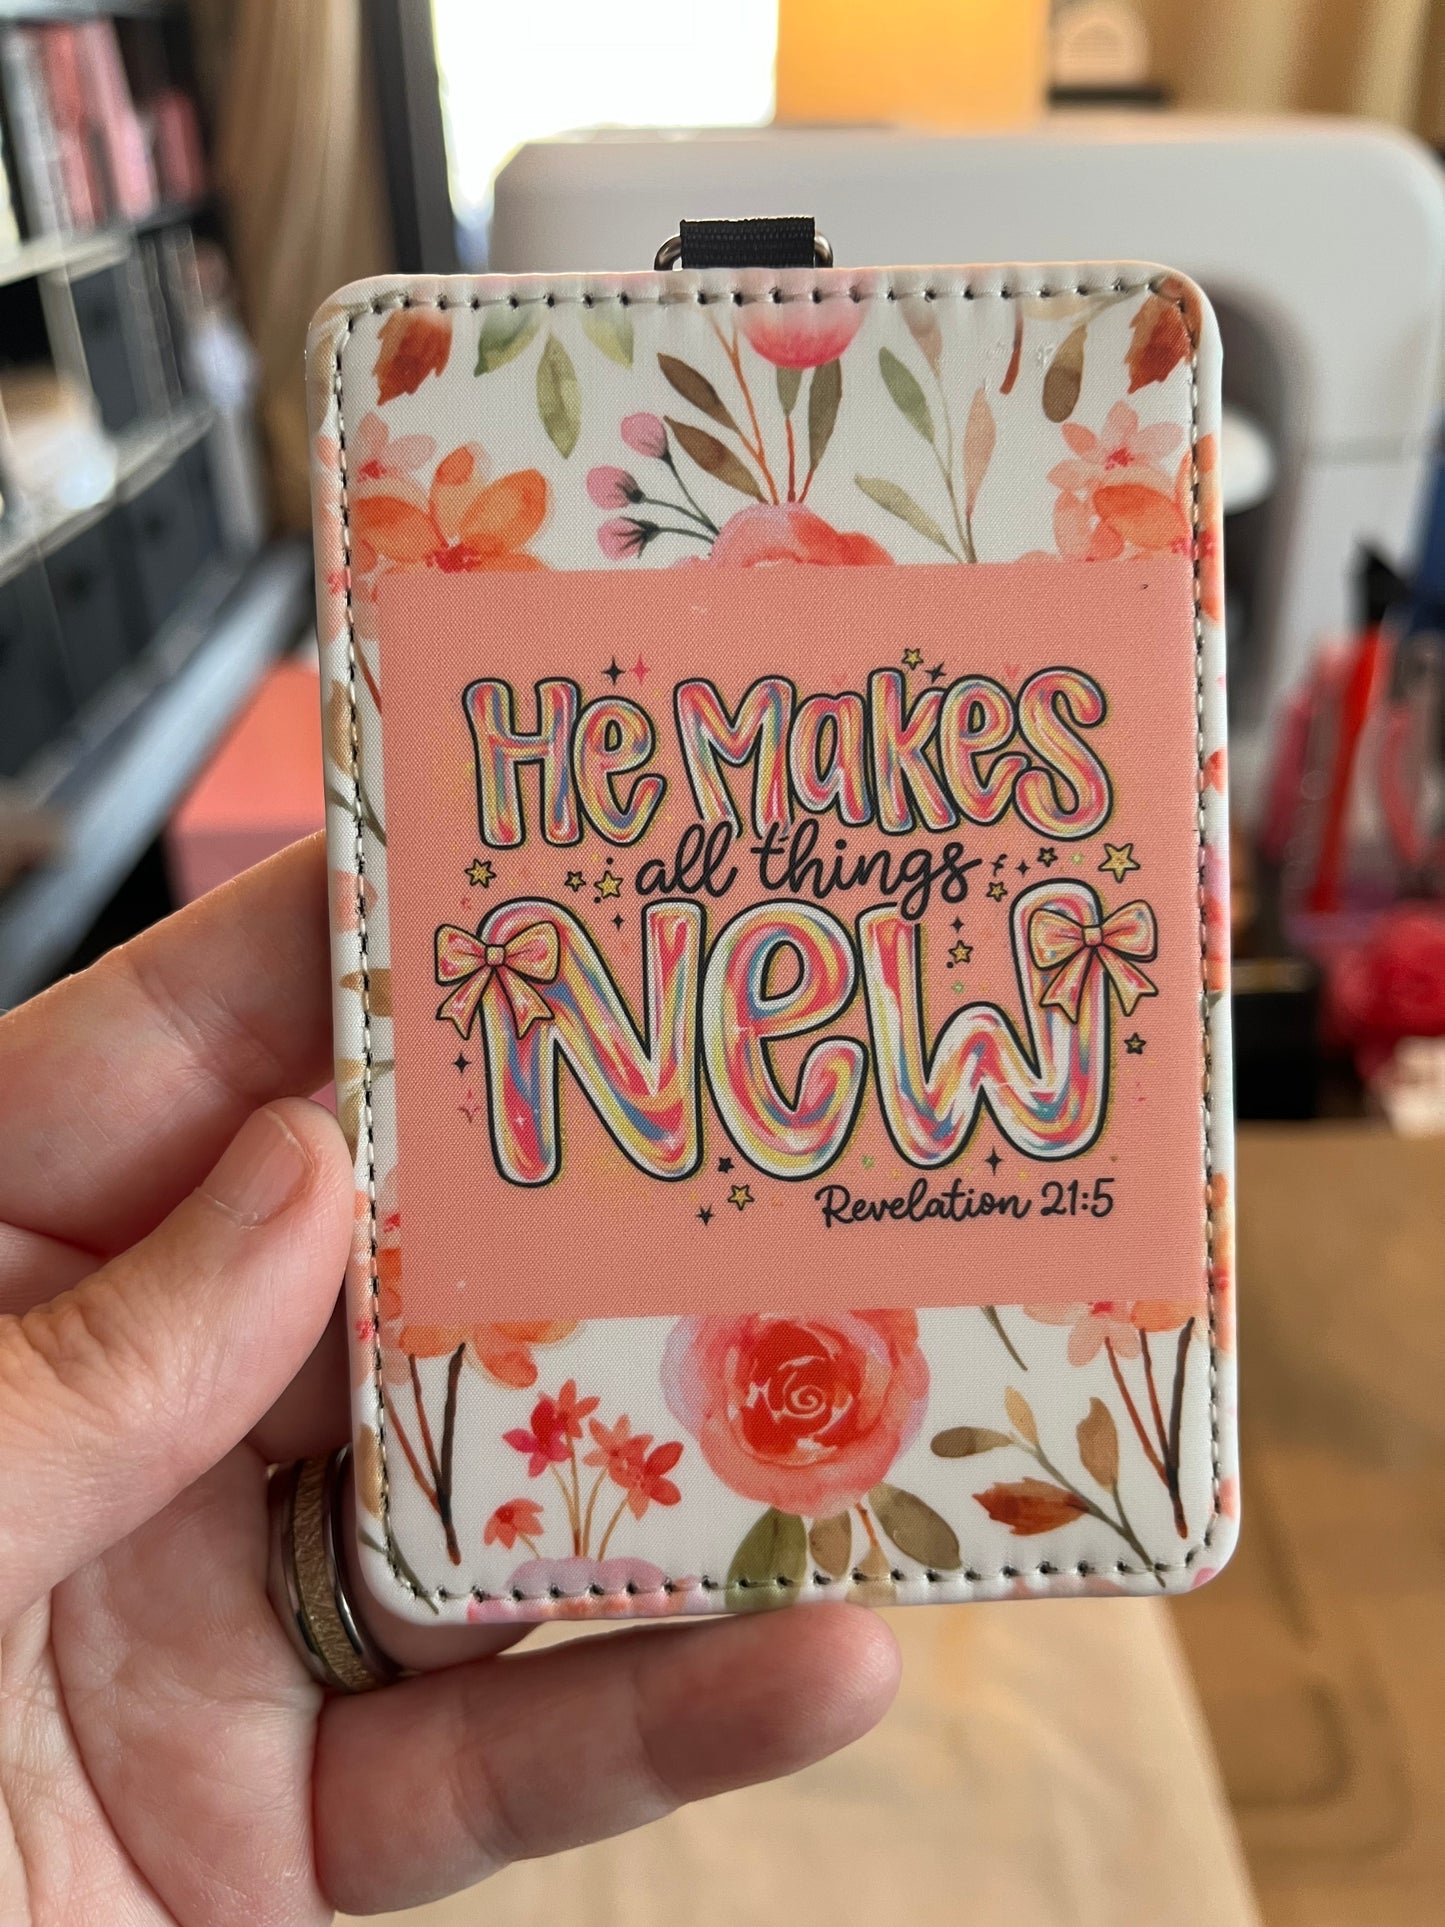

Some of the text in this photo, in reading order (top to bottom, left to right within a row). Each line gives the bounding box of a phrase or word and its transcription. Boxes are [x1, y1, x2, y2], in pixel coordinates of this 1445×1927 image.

[461, 676, 668, 851] He
[634, 817, 983, 921] all things
[478, 878, 1113, 1188] New
[814, 1177, 1116, 1228] Revelation 21:5
